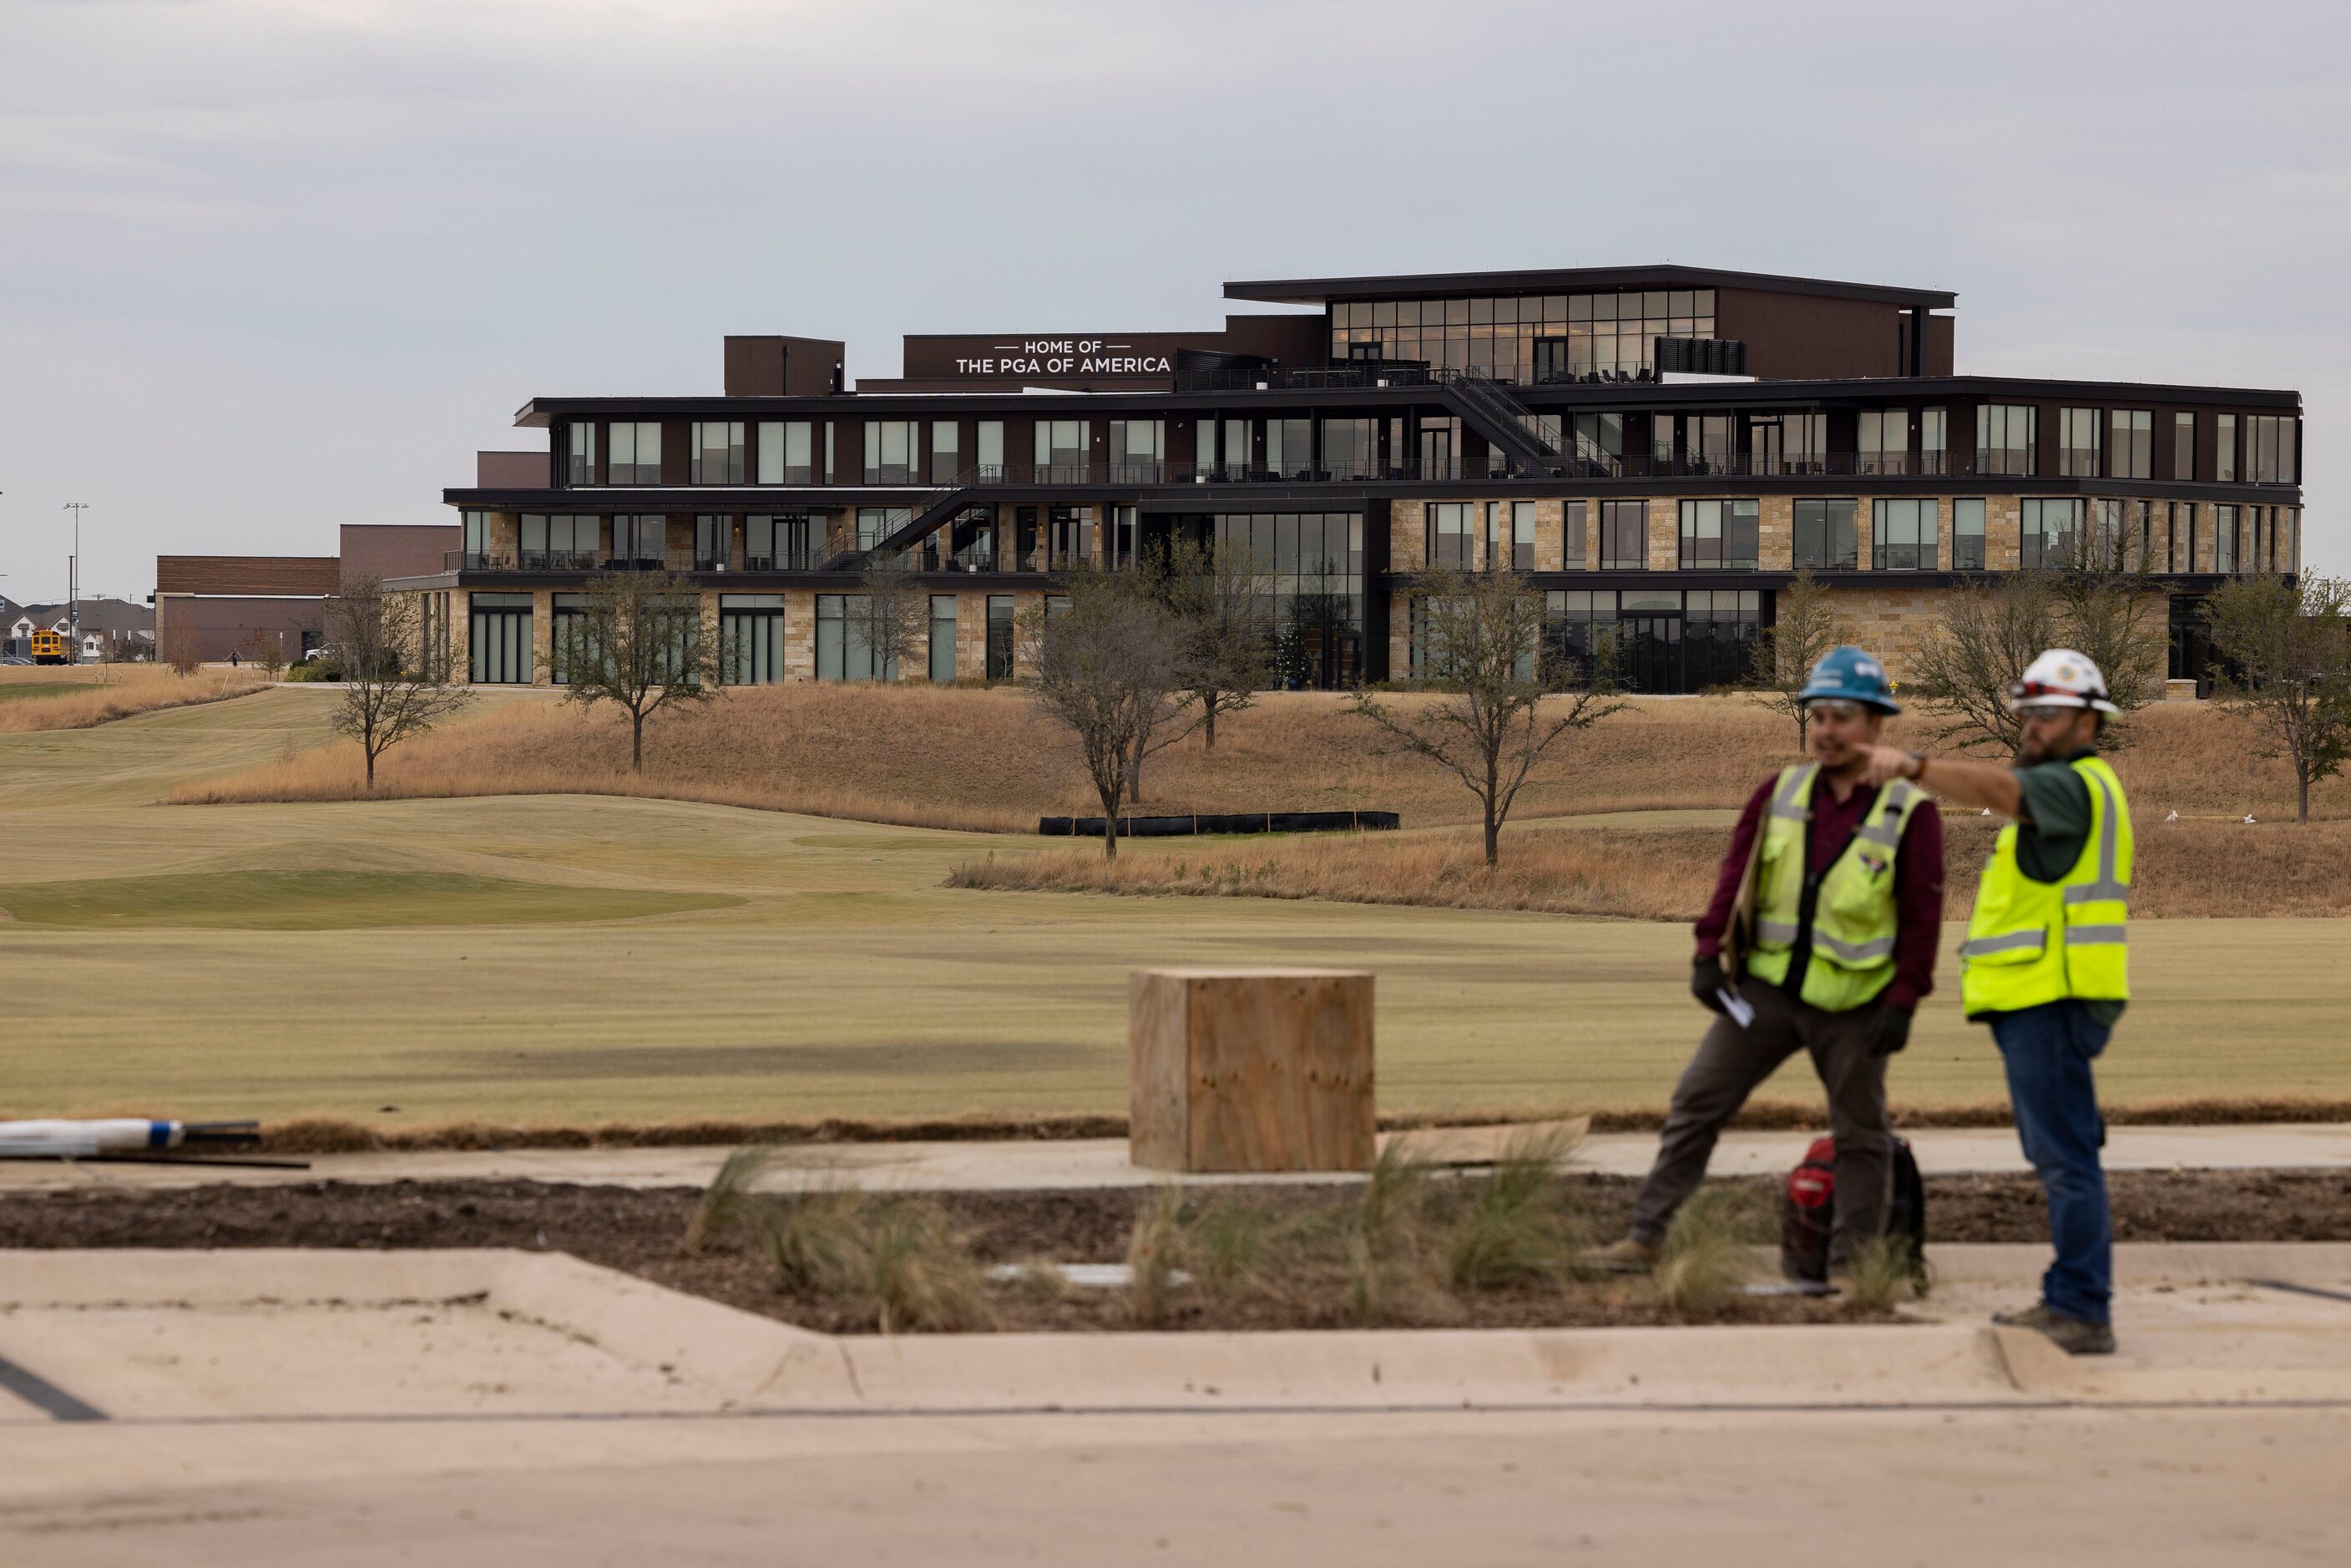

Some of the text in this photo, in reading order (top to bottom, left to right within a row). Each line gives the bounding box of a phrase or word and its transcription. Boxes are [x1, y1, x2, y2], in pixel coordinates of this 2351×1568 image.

[1025, 341, 1101, 353] HOME OF
[957, 357, 1170, 372] THE PGA OF AMERICA
